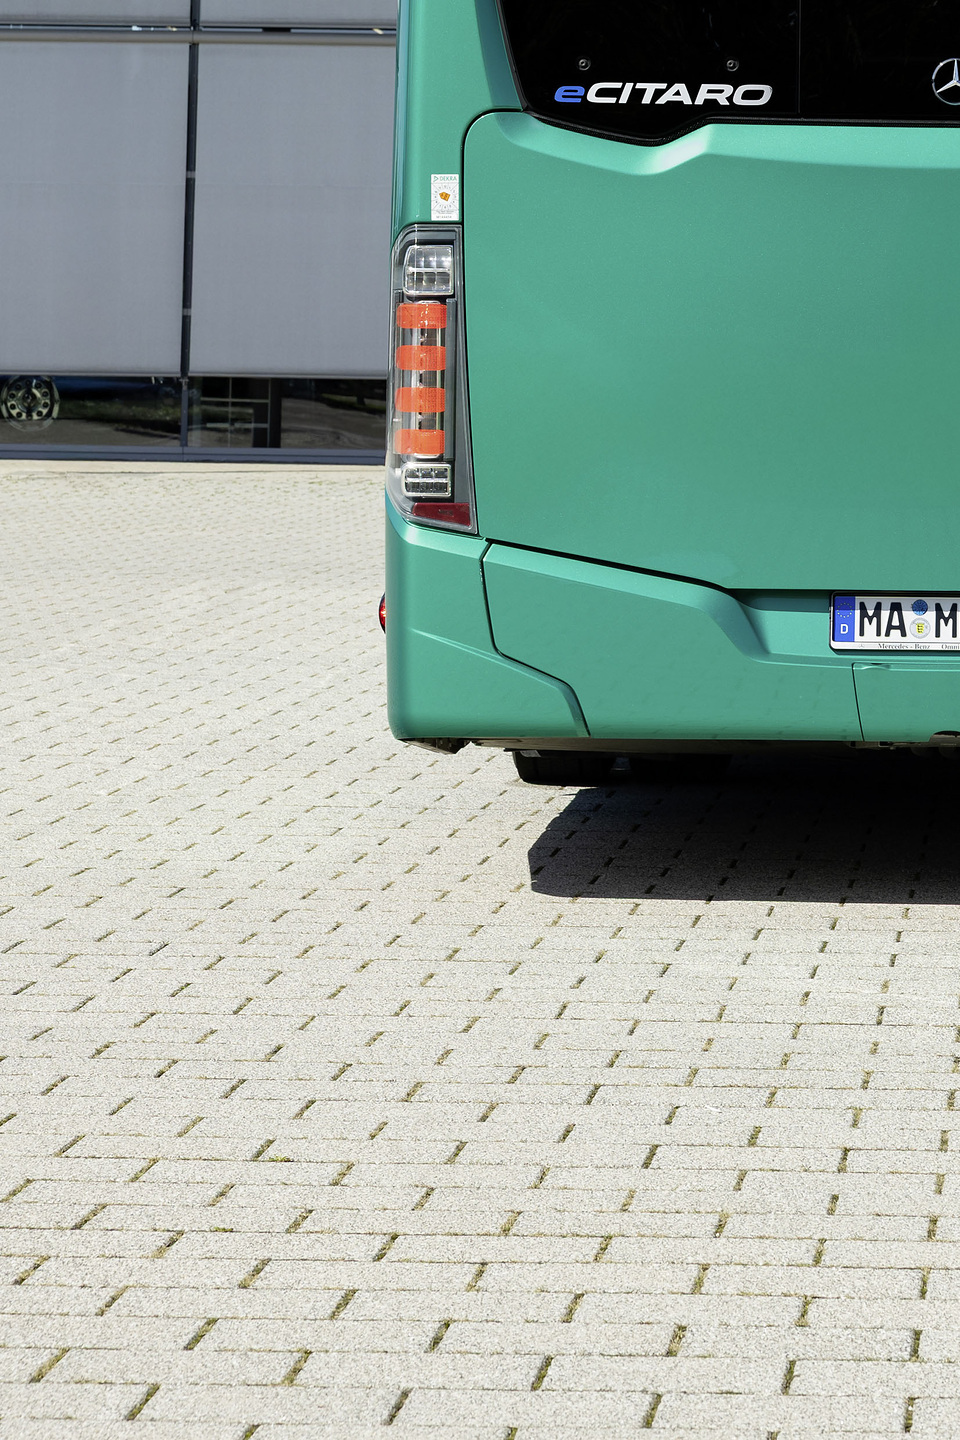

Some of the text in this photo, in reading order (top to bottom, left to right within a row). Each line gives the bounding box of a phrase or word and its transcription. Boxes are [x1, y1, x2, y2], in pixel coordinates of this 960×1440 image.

[553, 81, 774, 106] eCITARO
[840, 624, 849, 635] D
[858, 601, 908, 638] MA
